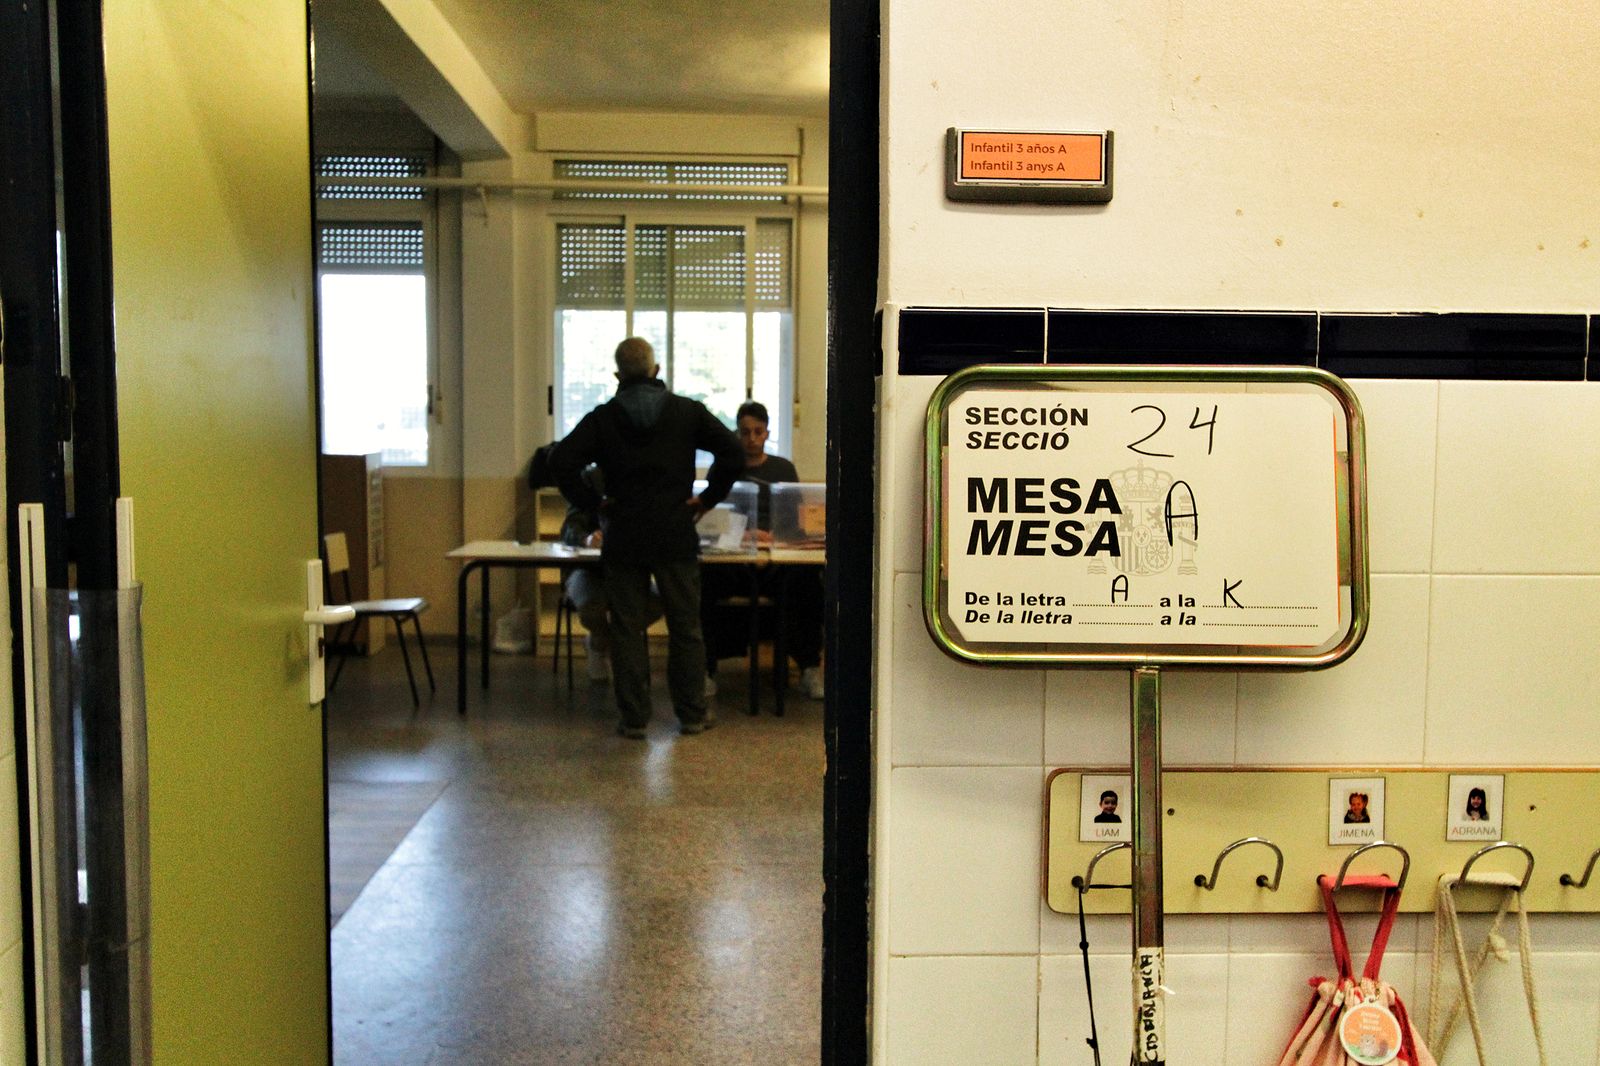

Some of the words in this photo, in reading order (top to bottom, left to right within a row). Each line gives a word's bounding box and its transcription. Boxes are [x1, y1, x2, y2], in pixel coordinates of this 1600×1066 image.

[970, 143, 1013, 153] Infantil
[1016, 143, 1024, 153] 3
[1026, 143, 1055, 154] años
[1057, 144, 1067, 154] A
[970, 160, 1013, 171] Infantil
[1016, 161, 1023, 171] 3
[1025, 162, 1054, 174] anys
[1056, 162, 1066, 172] A
[965, 403, 1089, 426] SECCIÓN
[965, 428, 1070, 451] SECCIÓ
[1126, 405, 1218, 458] 24
[967, 477, 1123, 515] MESA
[1164, 480, 1199, 547] A
[966, 519, 1122, 557] MESA
[965, 591, 990, 606] De
[996, 592, 1014, 606] la
[1020, 592, 1067, 607] letra
[1111, 574, 1129, 604] A
[1159, 596, 1171, 608] a
[1178, 594, 1196, 608] la
[1222, 578, 1244, 609] K
[965, 609, 990, 624] De
[996, 610, 1015, 624] la
[1020, 610, 1073, 625] lletra
[1160, 614, 1172, 626] a
[1178, 612, 1197, 626] la
[1095, 828, 1120, 838] LIAM
[1337, 828, 1376, 838] JIMENA
[1451, 825, 1497, 837] ADRIANA
